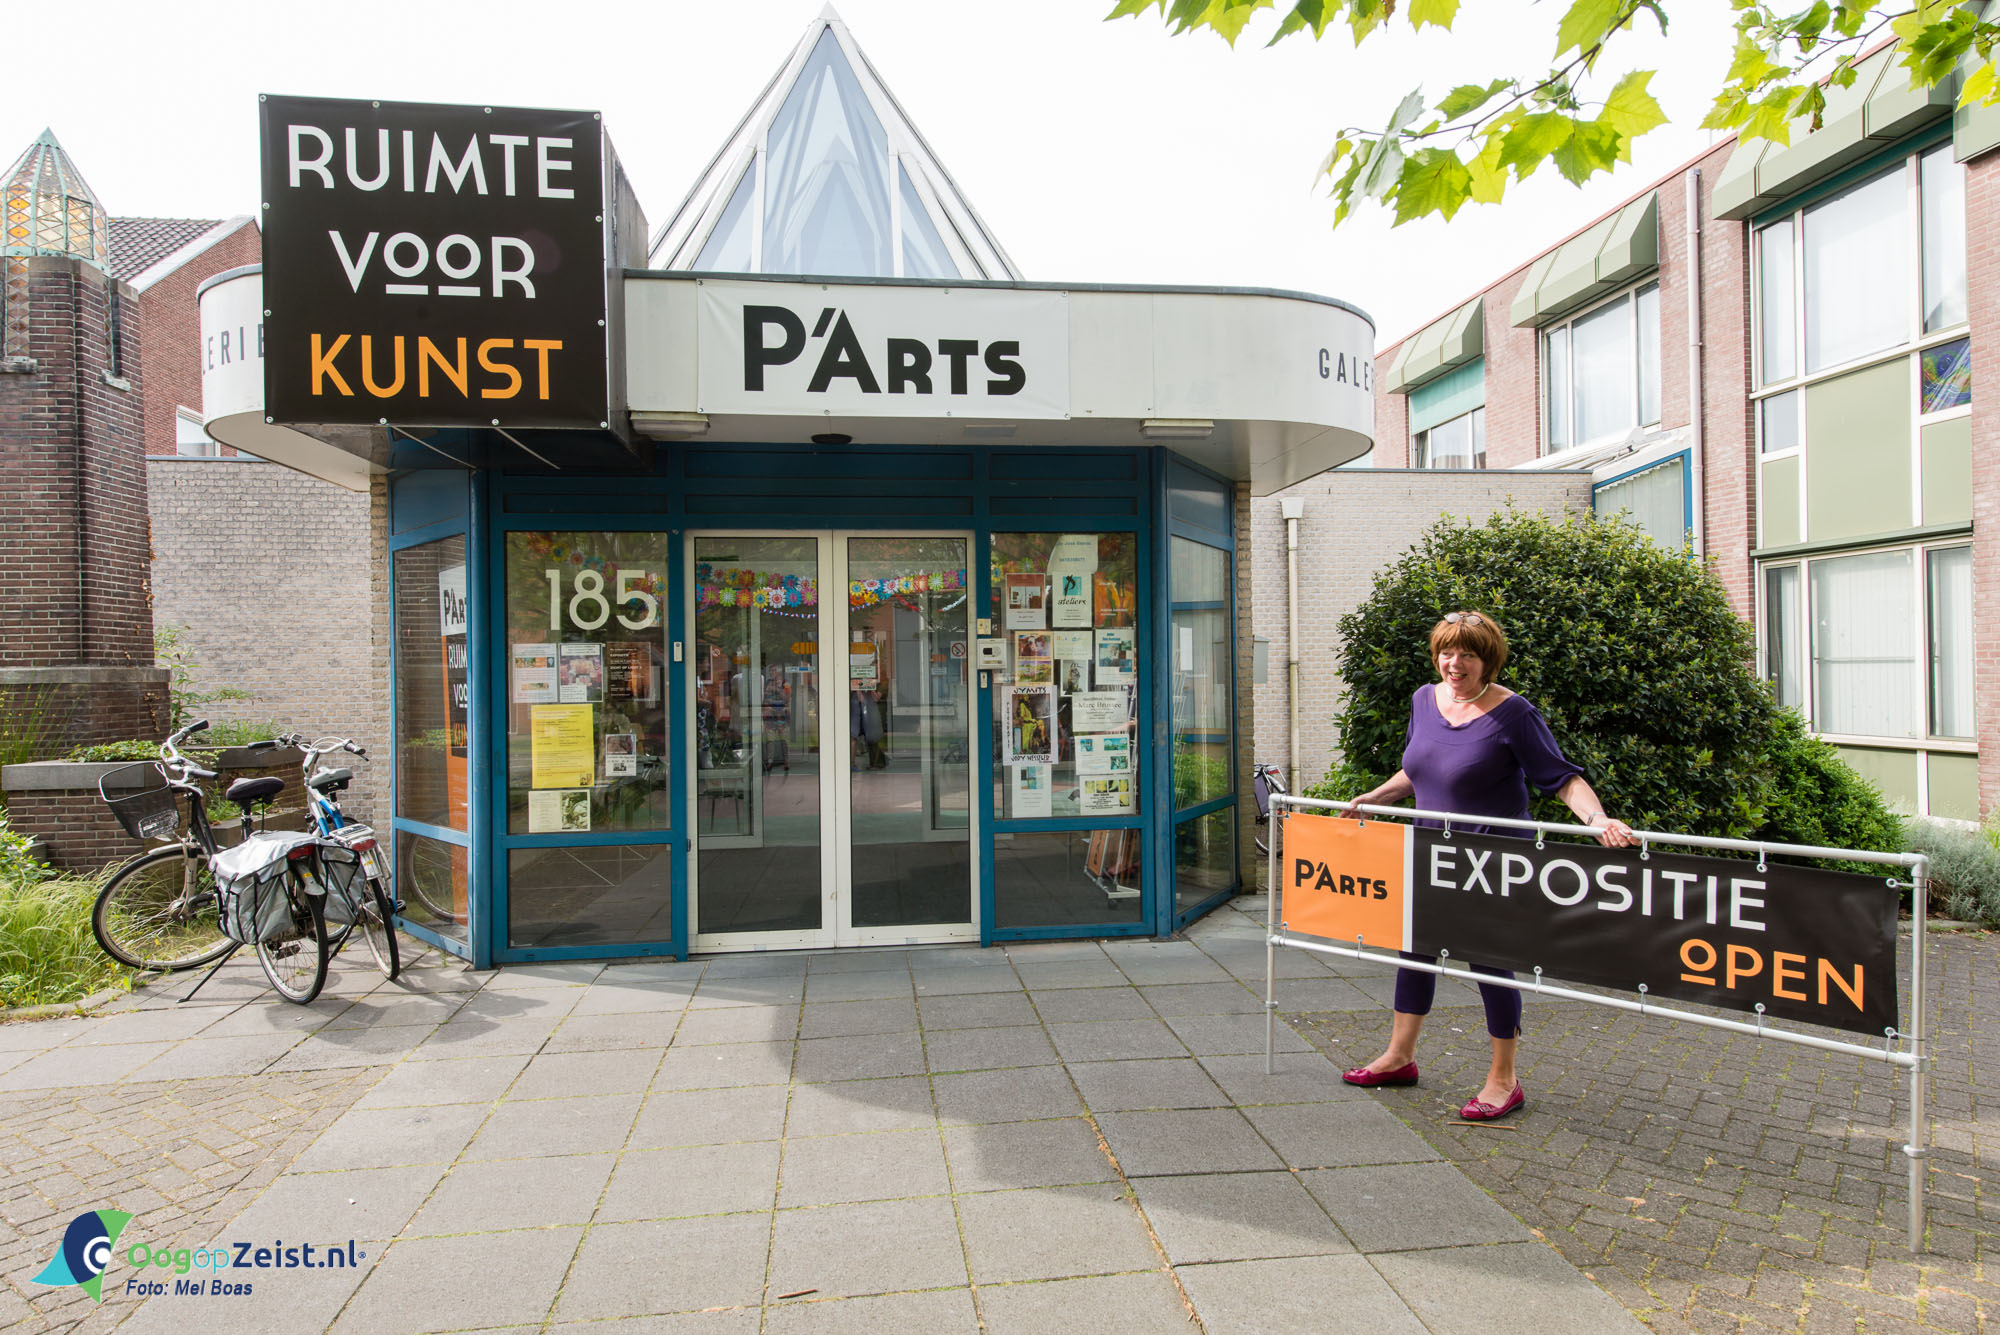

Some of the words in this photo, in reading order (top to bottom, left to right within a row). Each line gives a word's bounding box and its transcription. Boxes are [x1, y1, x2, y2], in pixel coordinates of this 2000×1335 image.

[288, 124, 575, 199] RUIMTE
[328, 230, 536, 299] VOOR
[311, 333, 563, 400] KUNST
[1318, 347, 1374, 392] GALE
[443, 587, 467, 626] P'AR
[545, 569, 657, 631] 185
[1430, 844, 1767, 932] EXPOSITIE
[1680, 939, 1864, 1013] OPEN
